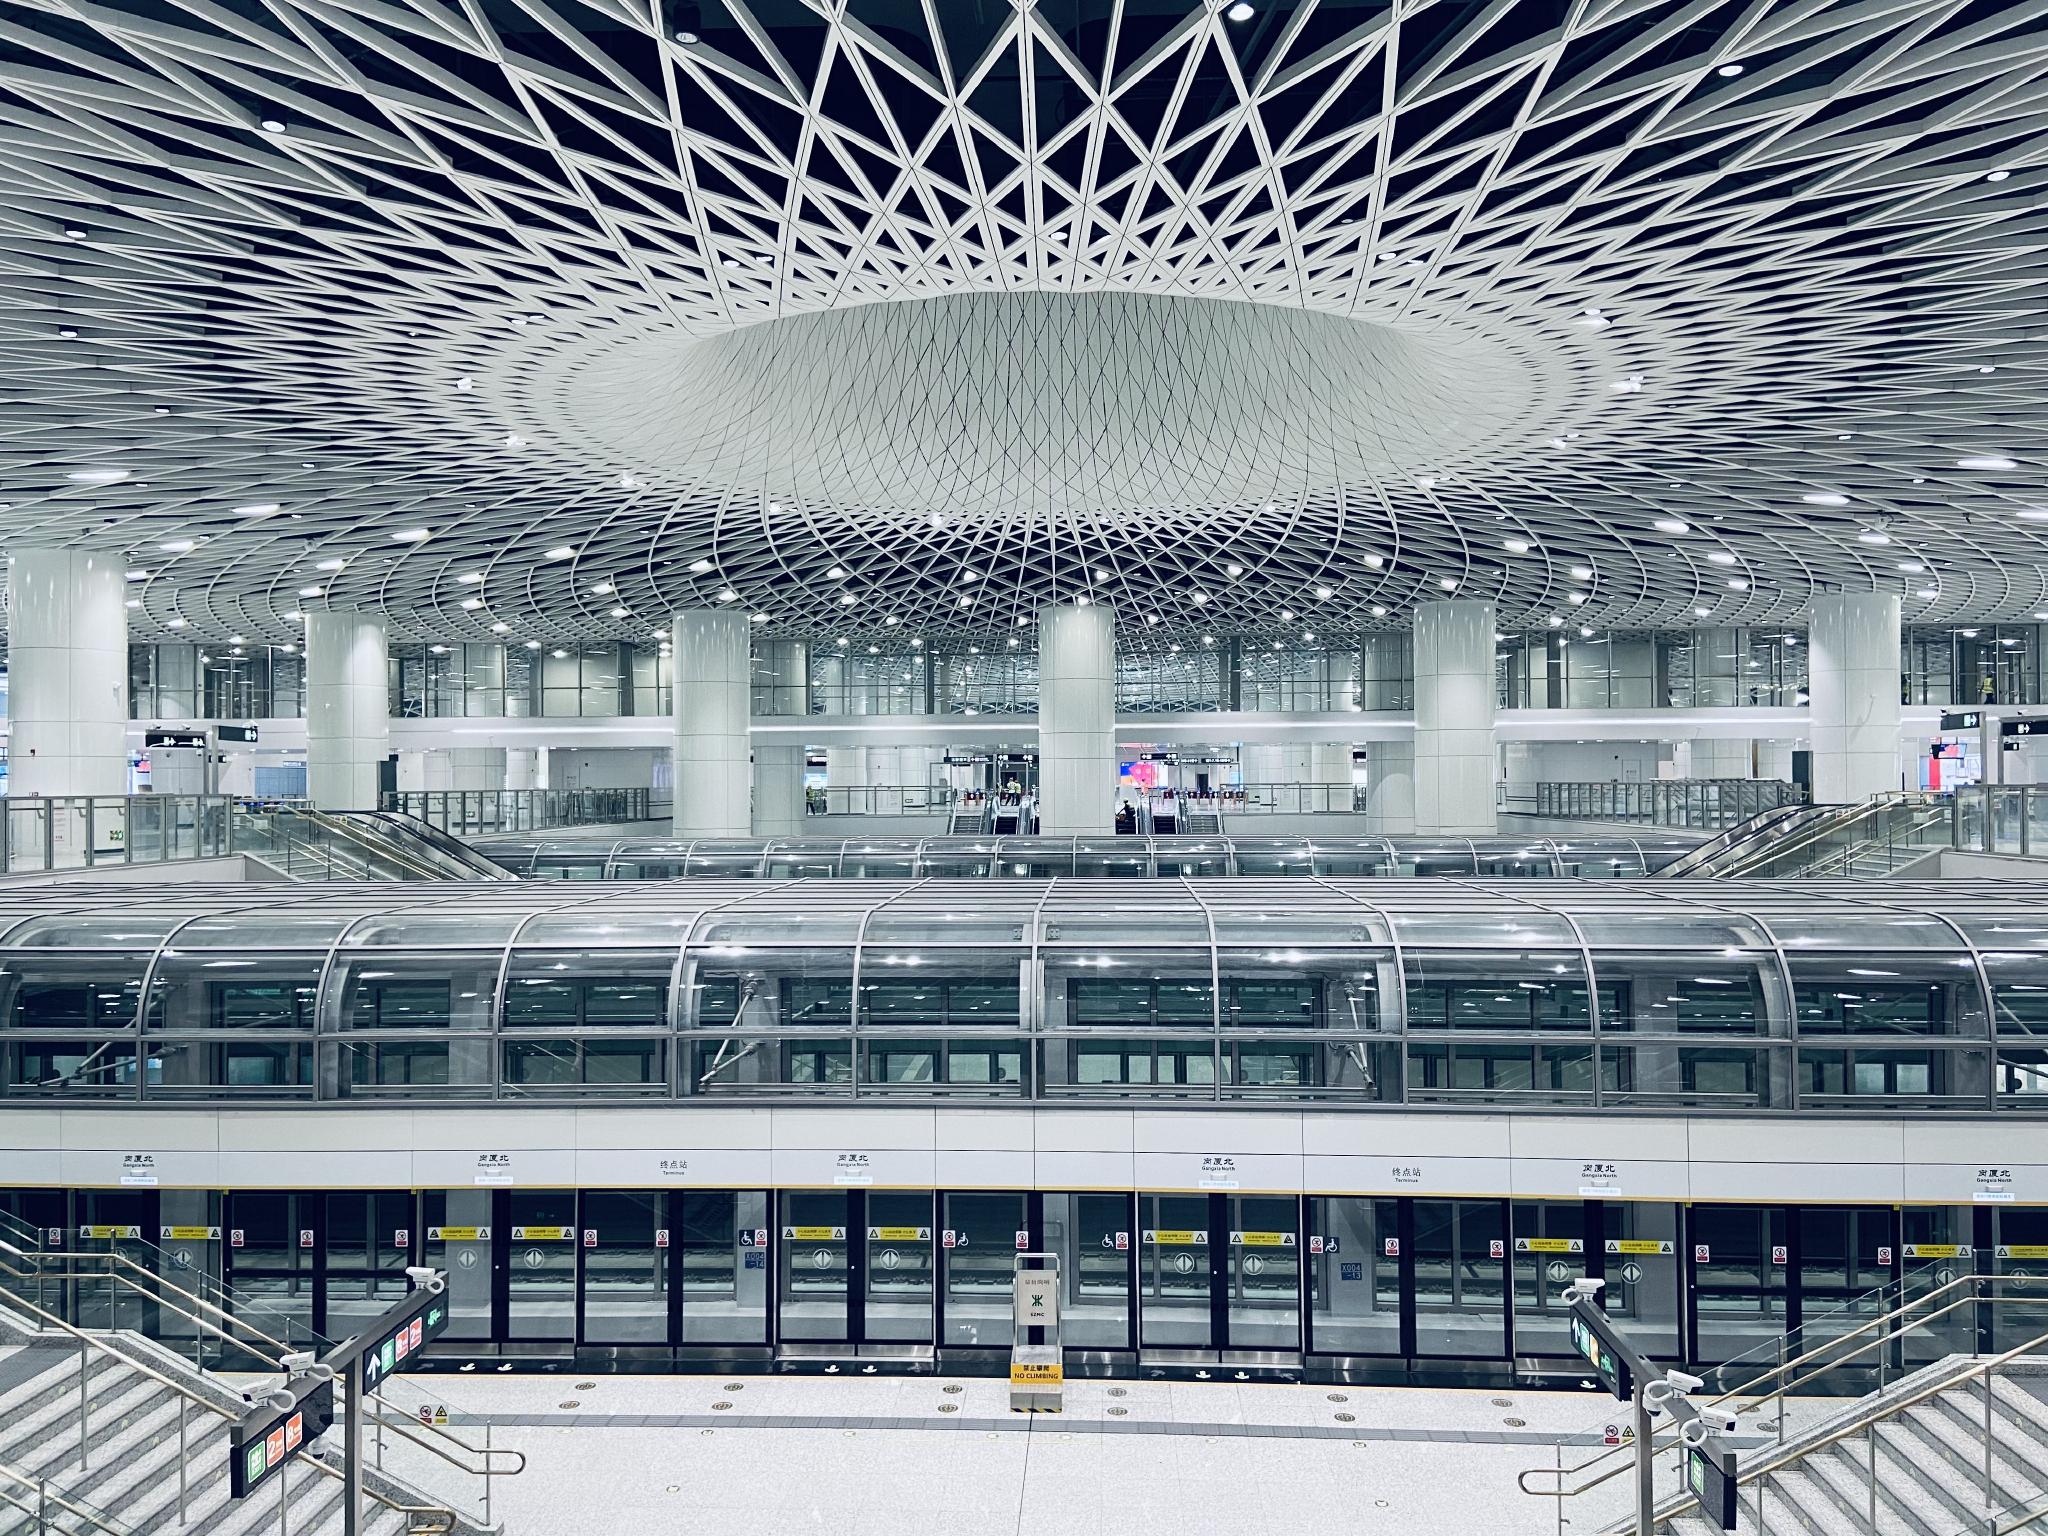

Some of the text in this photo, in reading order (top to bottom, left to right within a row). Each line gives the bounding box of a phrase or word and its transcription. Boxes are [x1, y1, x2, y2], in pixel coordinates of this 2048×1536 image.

[659, 1160, 688, 1169] 终点站
[1202, 1157, 1234, 1166] 岗厦北
[1391, 1167, 1421, 1177] 终点站
[1977, 1169, 2011, 1178] 岗厦北
[1341, 1263, 1361, 1272] X004
[1026, 1372, 1059, 1380] CLIMBING
